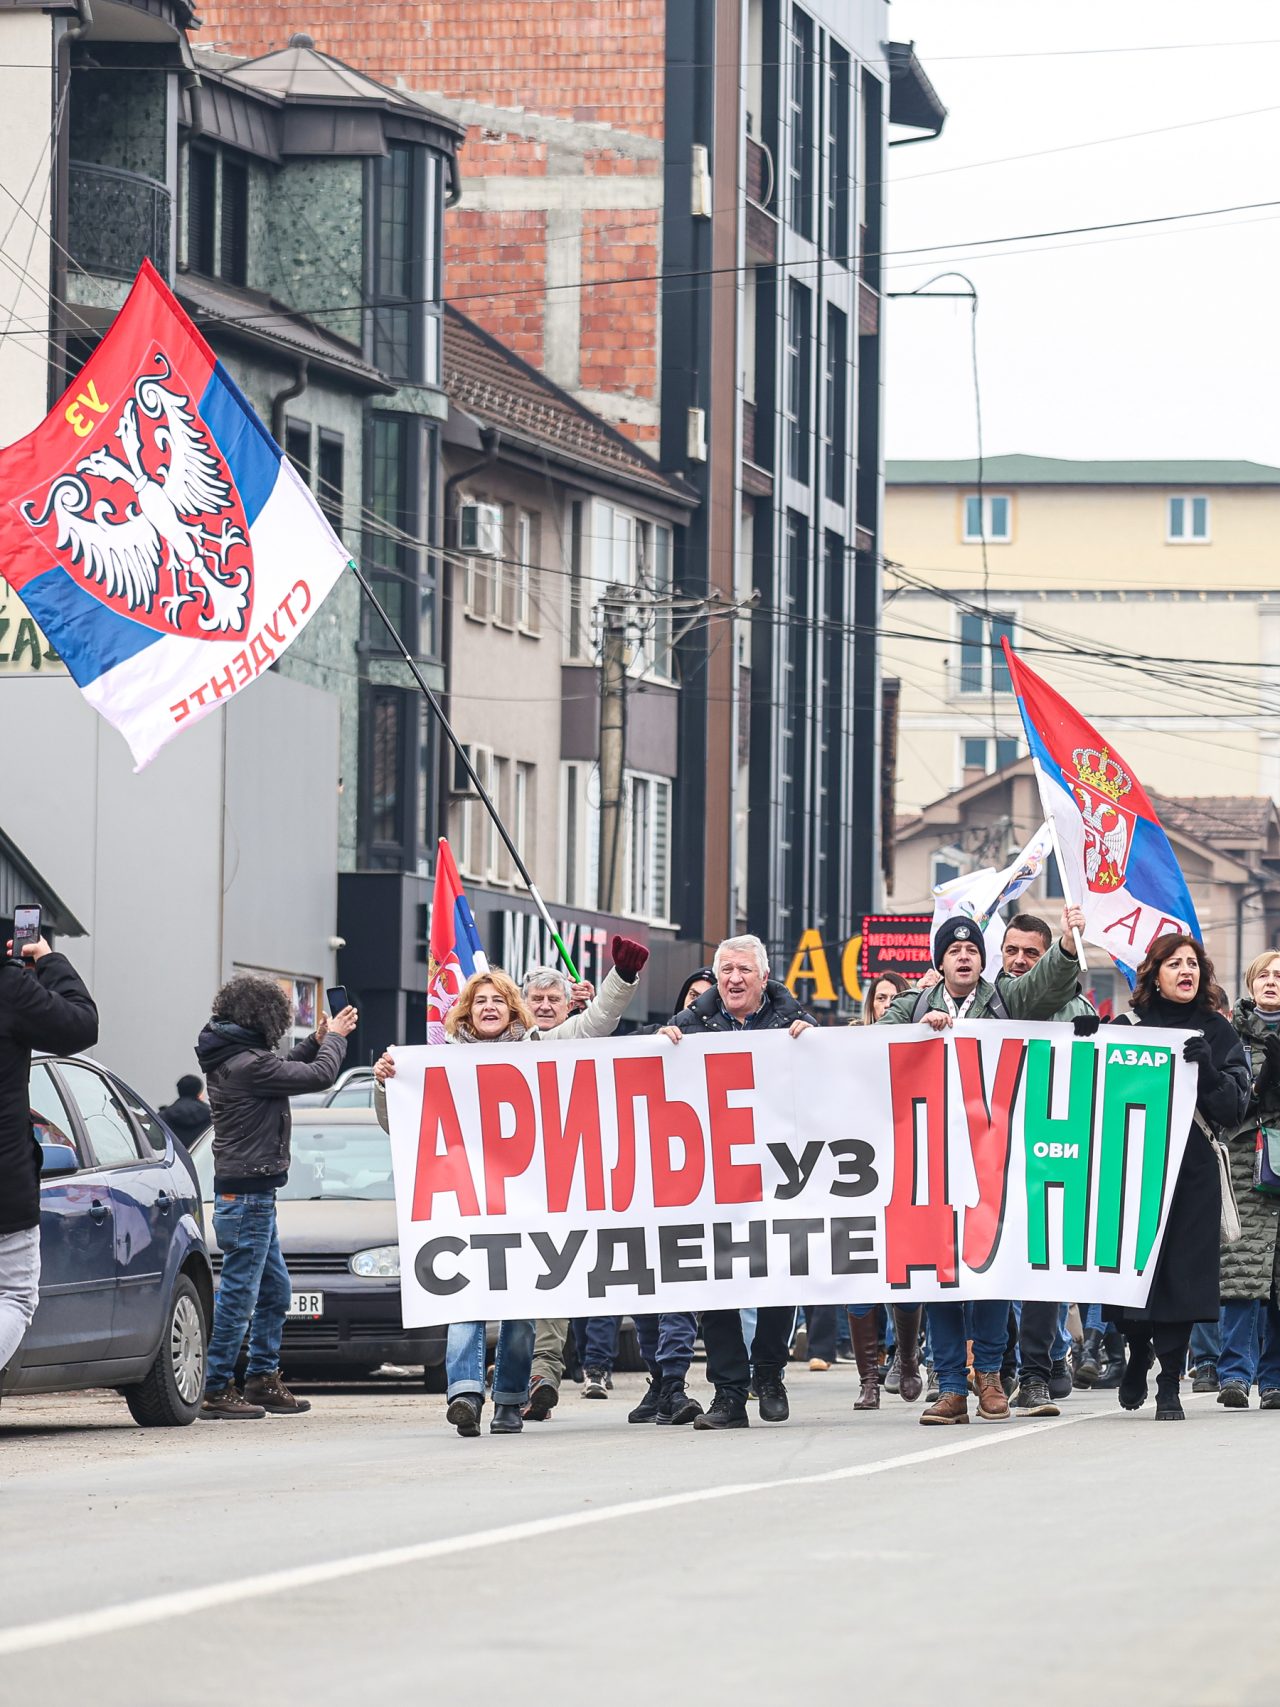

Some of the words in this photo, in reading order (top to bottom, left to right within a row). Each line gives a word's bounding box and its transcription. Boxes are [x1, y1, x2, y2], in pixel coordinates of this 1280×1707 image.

[1107, 1048, 1169, 1068] АЗАР
[411, 1051, 763, 1222] АРИЉЕ
[884, 1037, 1177, 1290] ДУНП
[1032, 1141, 1080, 1160] ОВИ
[414, 1215, 879, 1299] СТУДЕНТЕ
